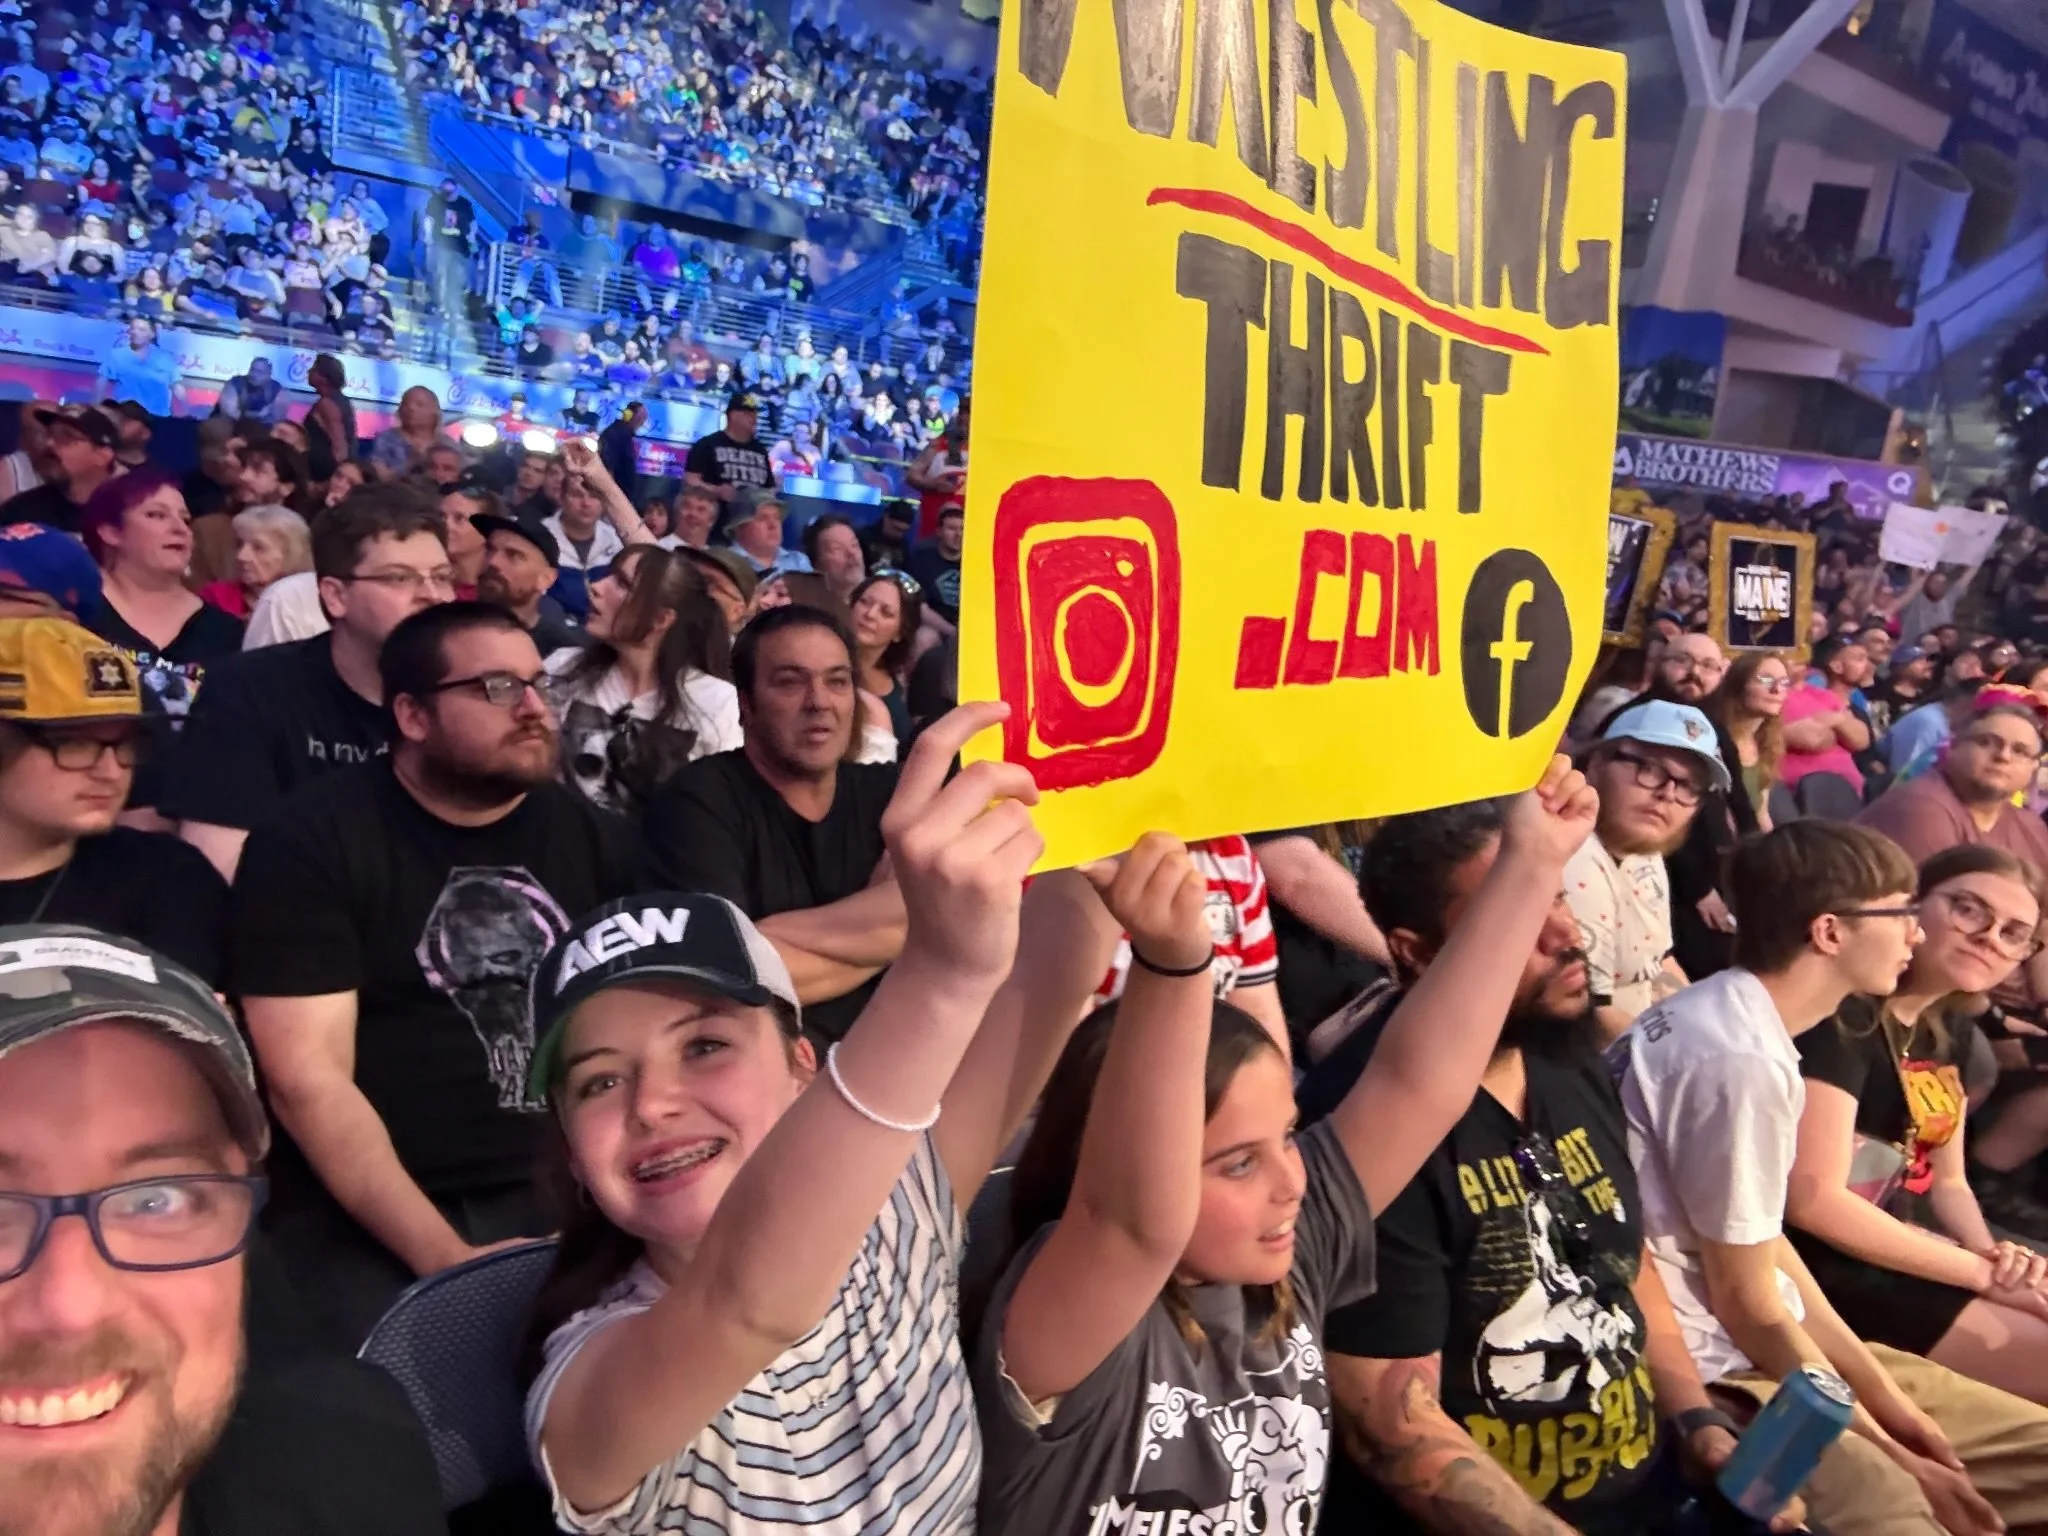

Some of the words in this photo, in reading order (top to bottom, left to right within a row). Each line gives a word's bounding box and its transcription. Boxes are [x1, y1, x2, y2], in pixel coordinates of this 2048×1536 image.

[1175, 230, 1512, 515] THRIFT
[1633, 459, 1775, 493] BROTHERS
[1637, 439, 1780, 472] MATHEWS
[554, 907, 691, 997] AEW
